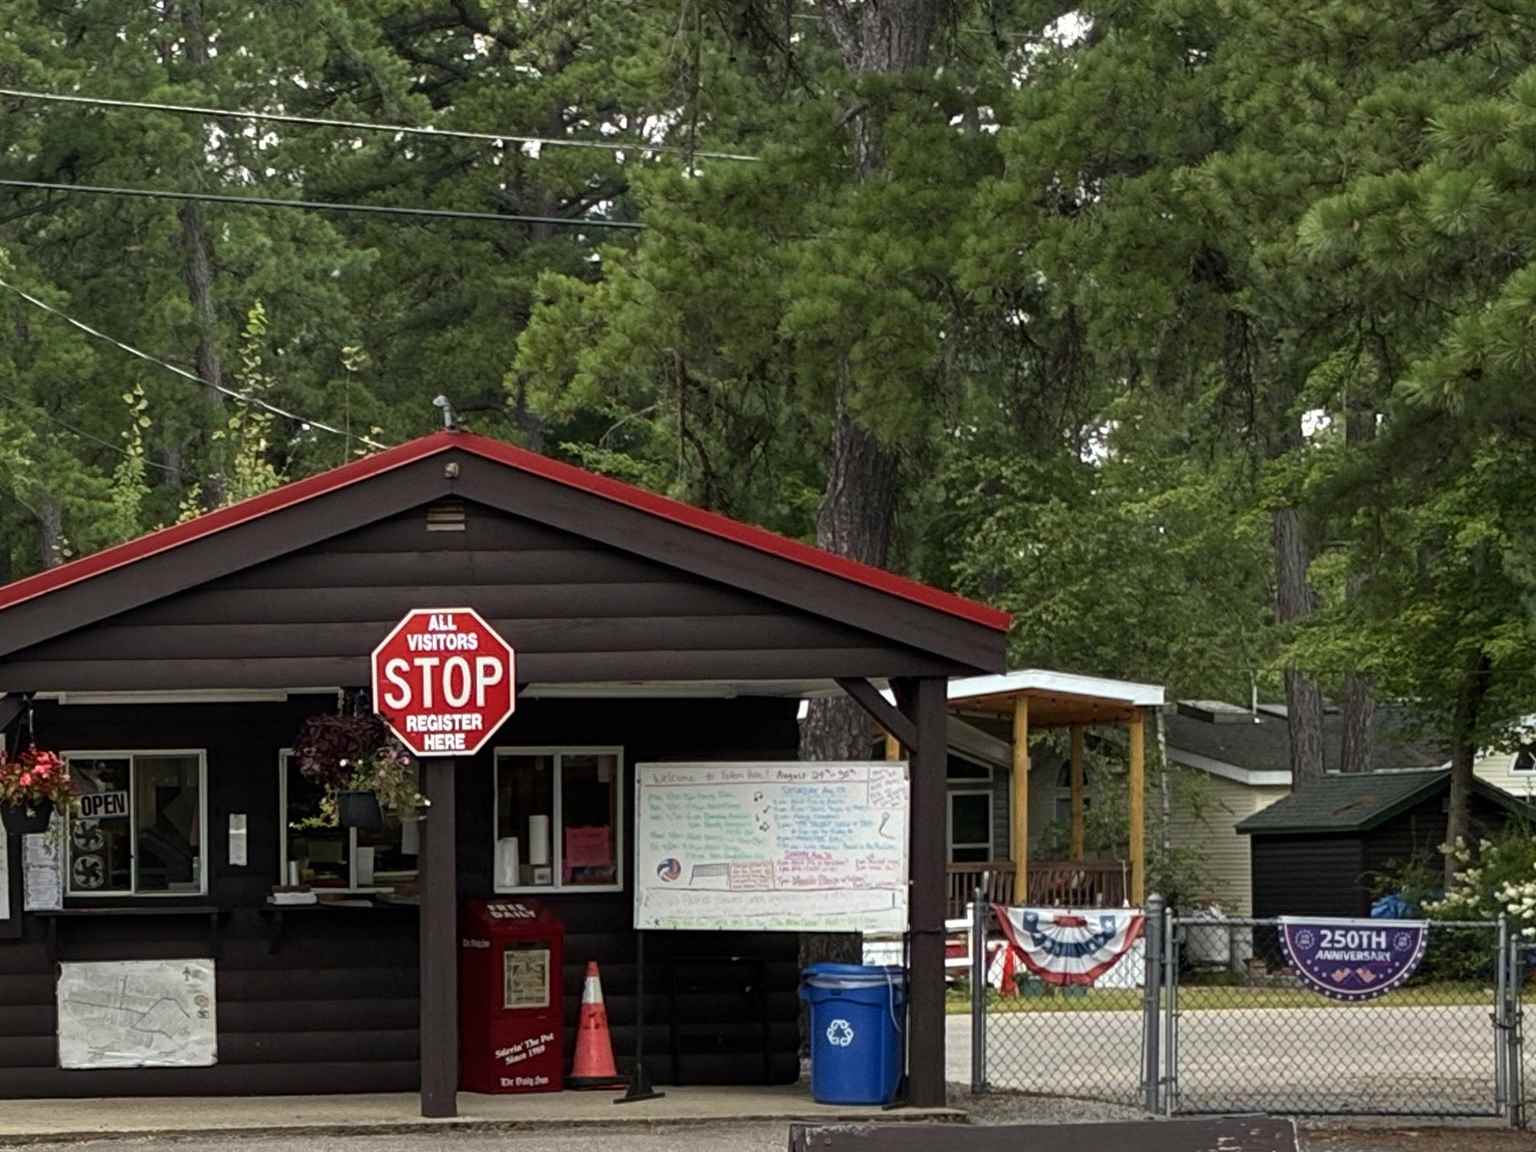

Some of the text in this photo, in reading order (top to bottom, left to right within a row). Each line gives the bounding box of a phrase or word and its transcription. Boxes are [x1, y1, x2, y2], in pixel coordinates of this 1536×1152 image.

[428, 614, 457, 631] ALL
[406, 632, 479, 651] VISITORS
[384, 656, 503, 710] STOP
[406, 713, 483, 732] REGISTER
[424, 733, 466, 751] HERE
[81, 793, 126, 816] OPEN
[1319, 929, 1387, 949] 250TH
[1314, 950, 1392, 961] ANNIVERSARY
